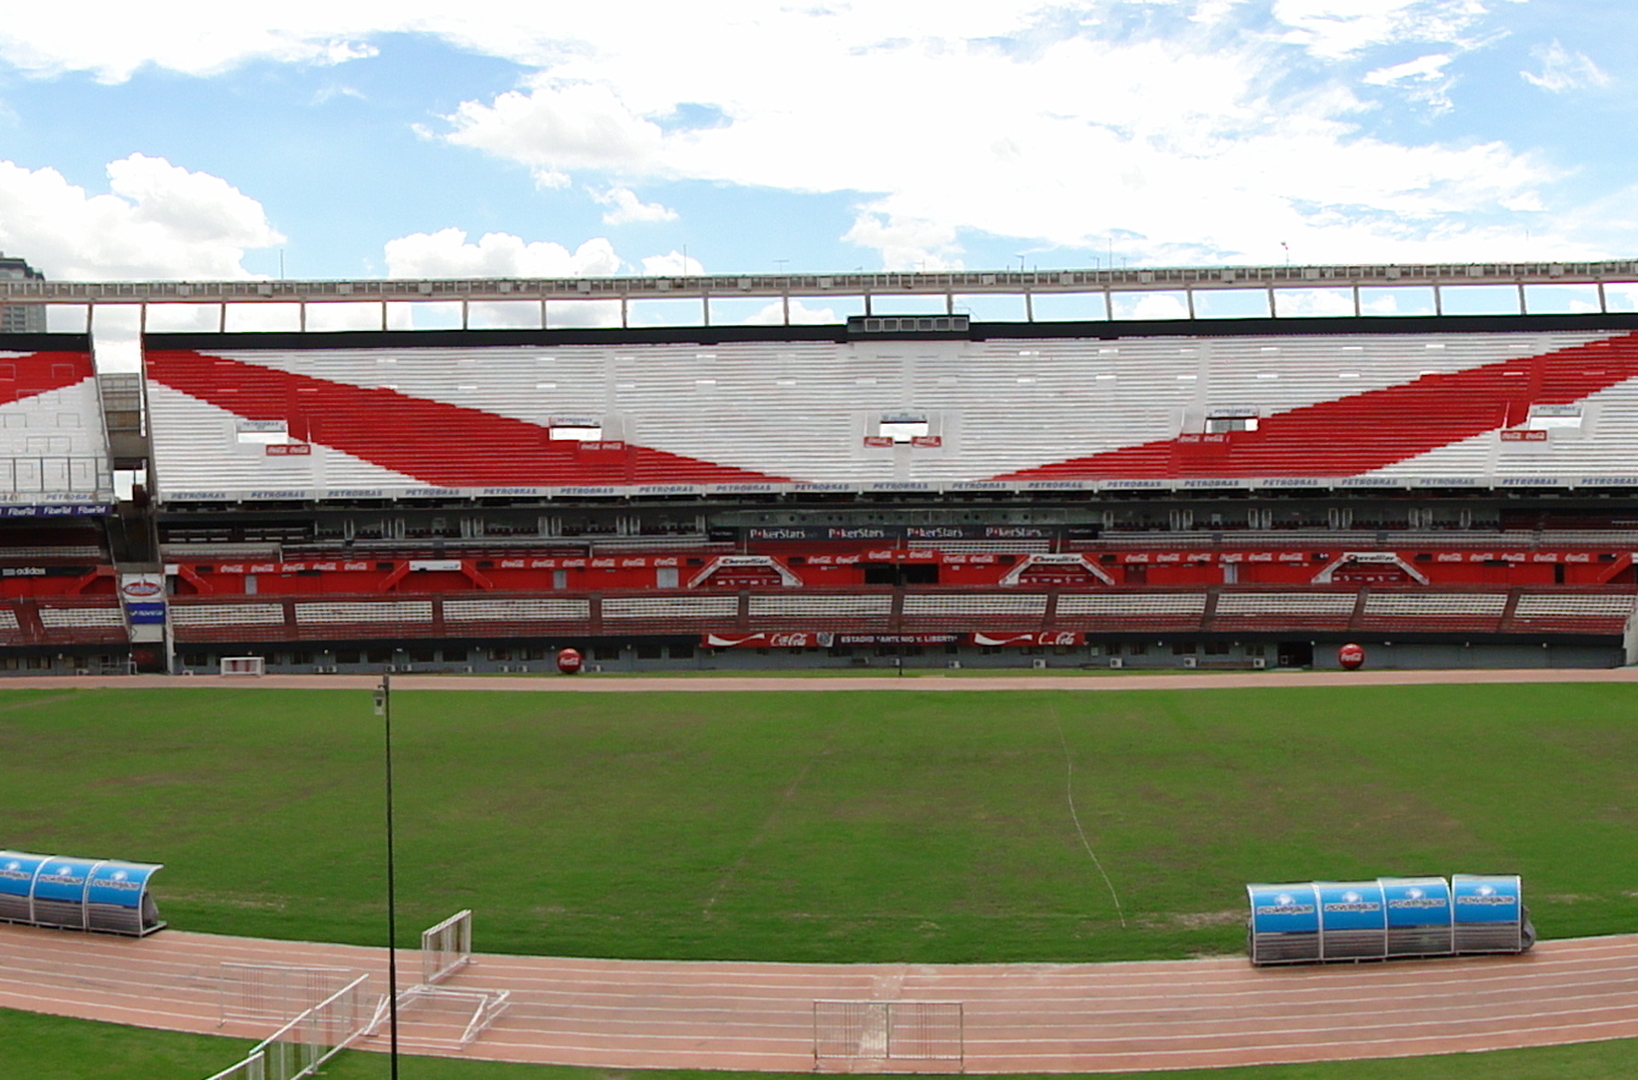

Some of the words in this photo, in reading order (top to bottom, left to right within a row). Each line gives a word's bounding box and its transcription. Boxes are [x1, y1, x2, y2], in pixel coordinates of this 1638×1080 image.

[750, 528, 805, 539] PokerStars
[828, 528, 884, 538] PokerStars
[907, 528, 962, 538] PokerStars
[985, 527, 1042, 538] PokerStars
